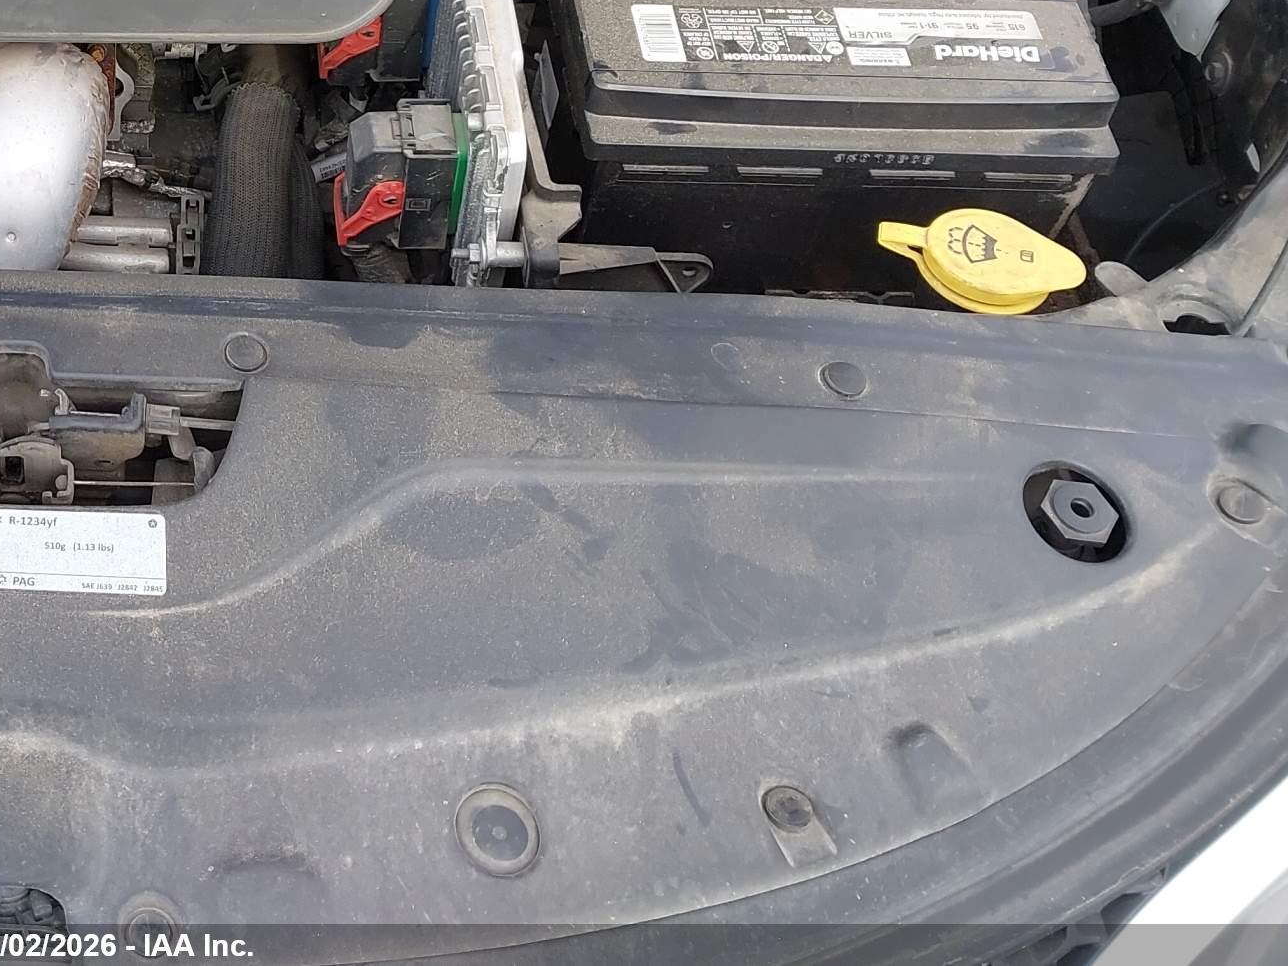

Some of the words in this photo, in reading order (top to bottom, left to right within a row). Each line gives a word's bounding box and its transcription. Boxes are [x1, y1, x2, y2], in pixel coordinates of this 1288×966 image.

[848, 30, 893, 39] SILVER
[723, 51, 823, 63] DANGER/POISON
[934, 44, 1041, 63] DieHard
[8, 516, 57, 529] R-1234yf
[44, 542, 66, 551] 510g
[73, 542, 94, 552] (1.13
[97, 543, 114, 553] lbs)
[12, 576, 35, 587] PAG
